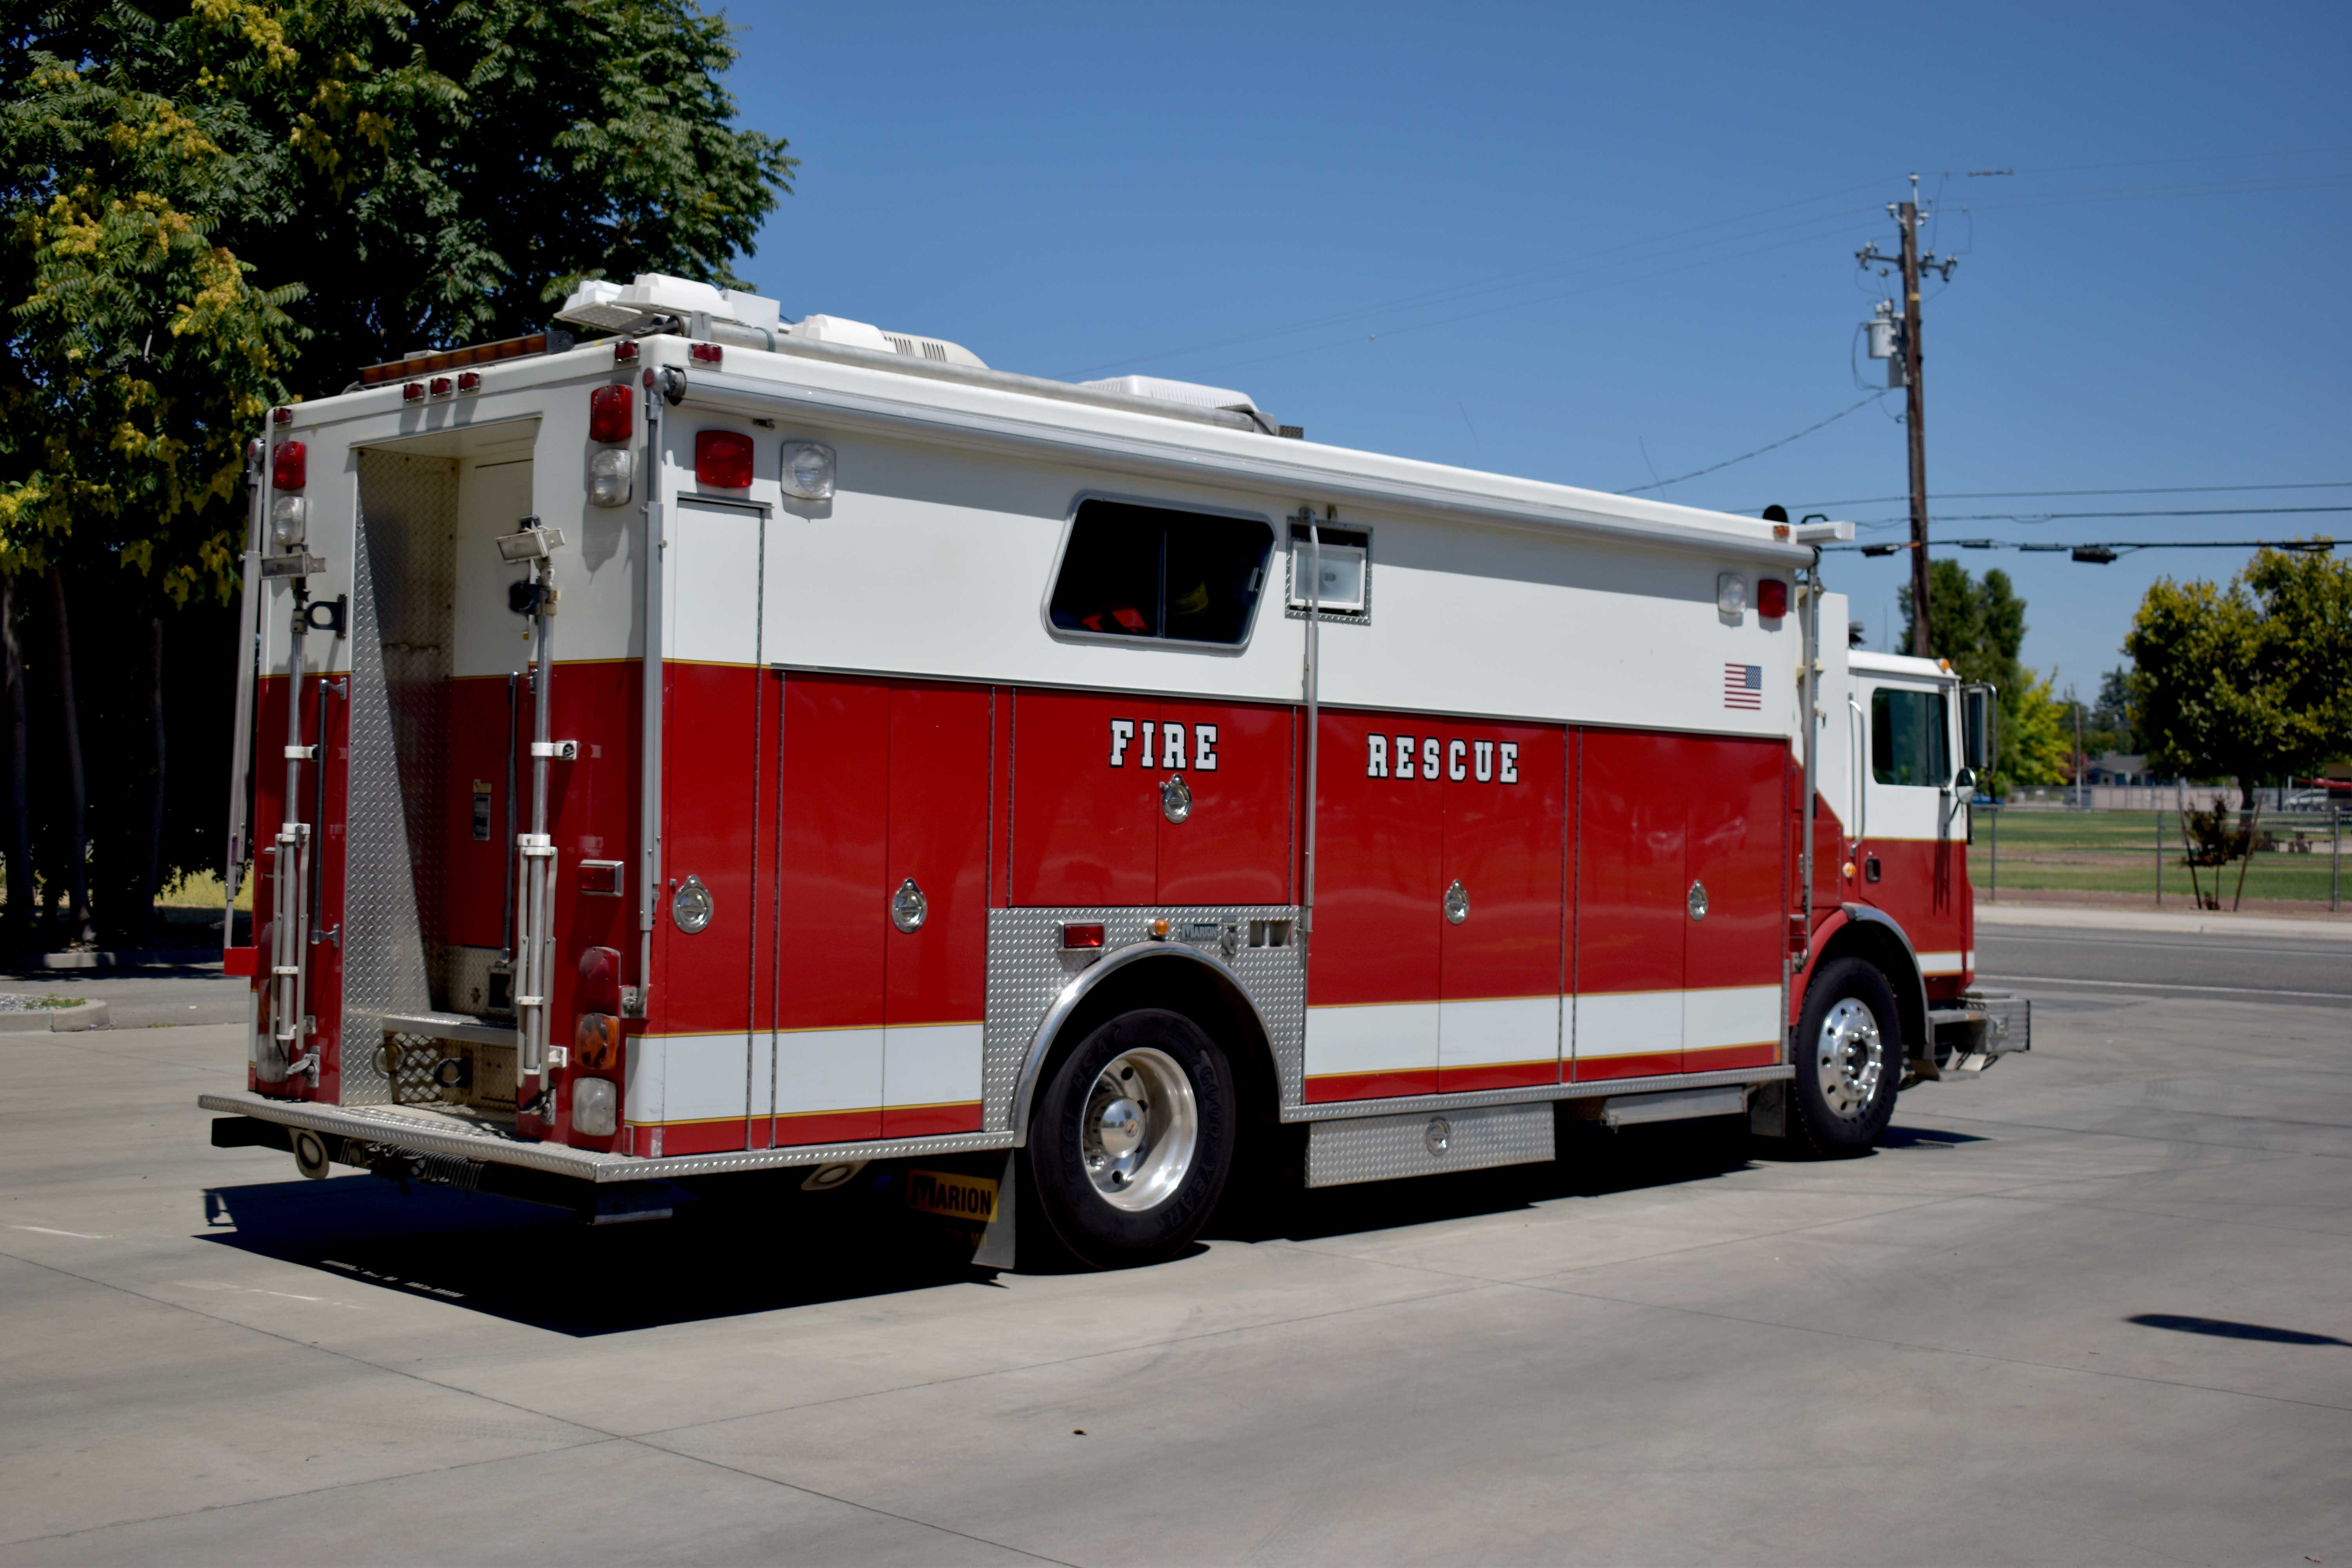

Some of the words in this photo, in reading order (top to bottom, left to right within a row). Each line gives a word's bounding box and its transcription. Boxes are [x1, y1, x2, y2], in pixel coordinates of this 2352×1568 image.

[1110, 718, 1218, 770] FIRE
[1367, 733, 1518, 784] RESCUE
[1181, 923, 1217, 938] MARION
[913, 1174, 991, 1215] MARION
